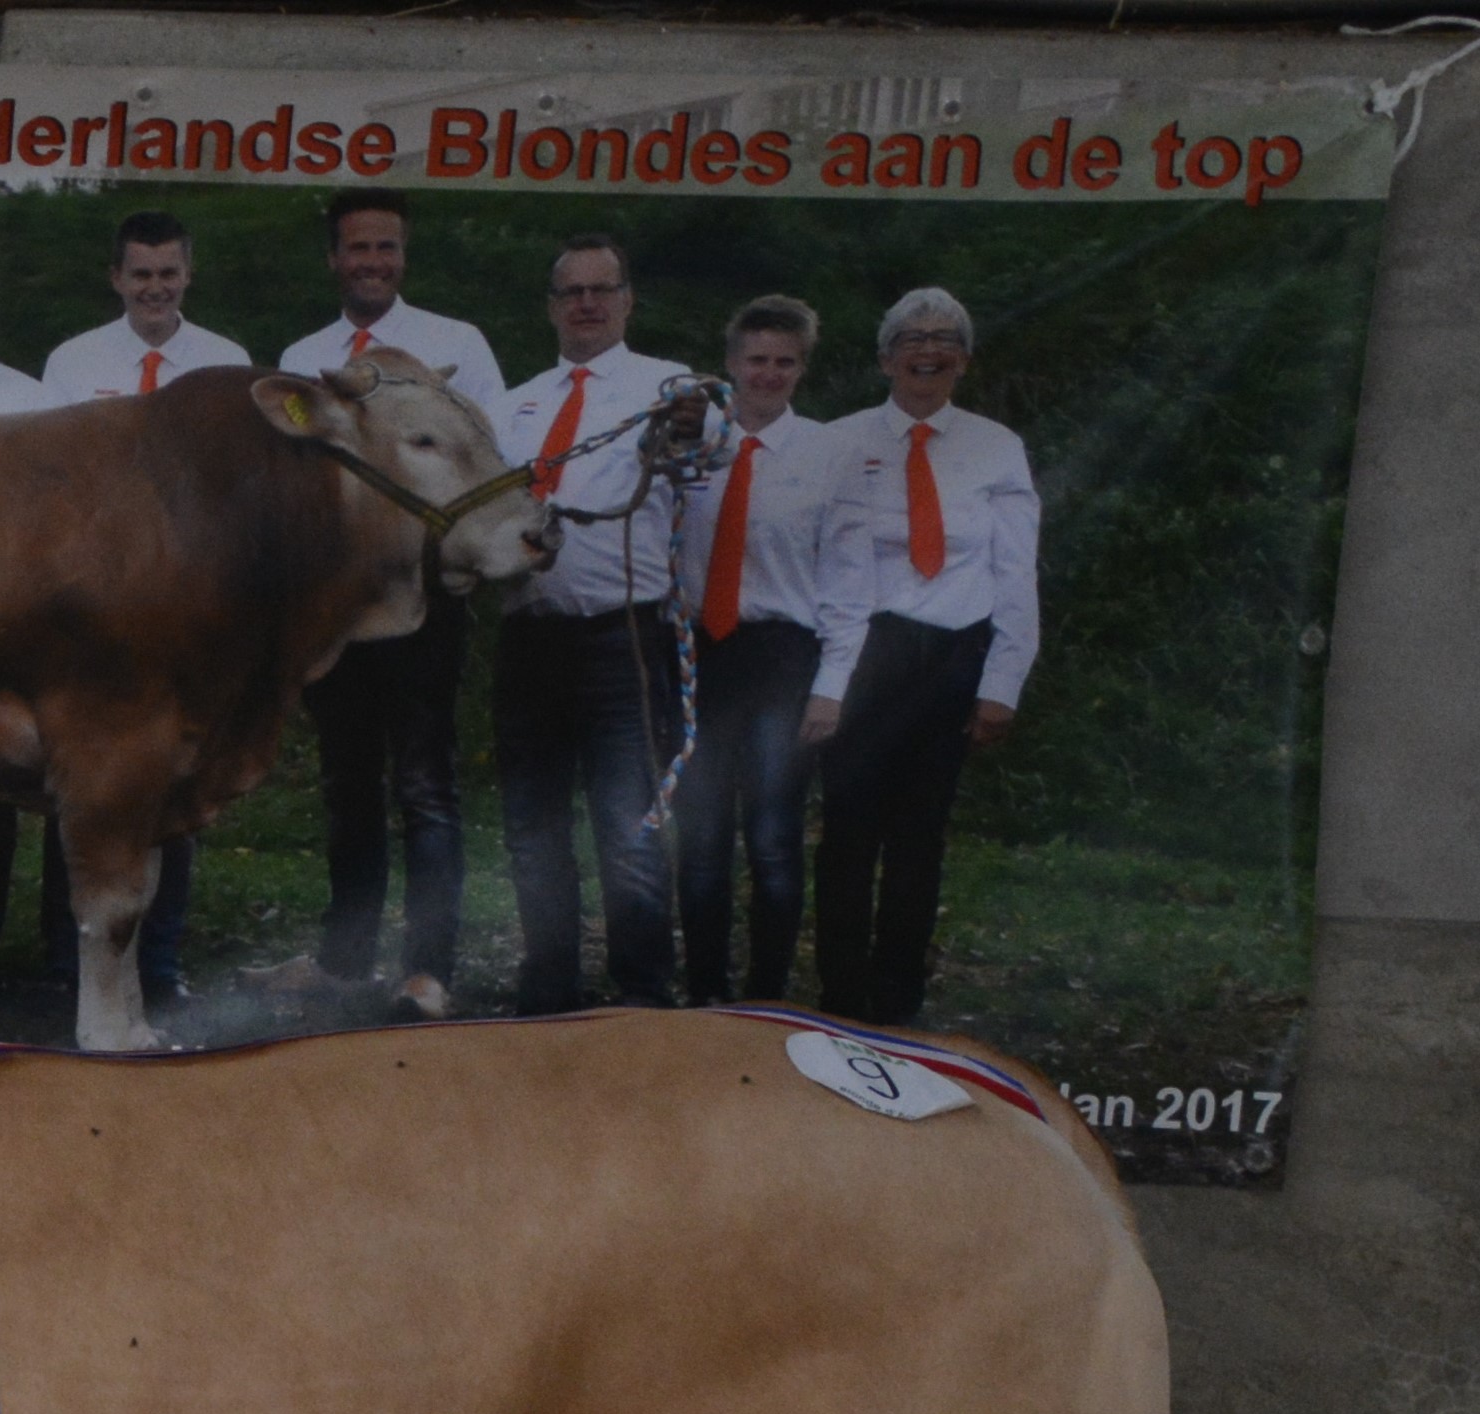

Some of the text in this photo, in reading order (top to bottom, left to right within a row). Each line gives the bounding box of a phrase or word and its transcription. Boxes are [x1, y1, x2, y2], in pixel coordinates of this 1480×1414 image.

[425, 106, 793, 188] Blondes
[819, 129, 982, 189] aan
[1012, 116, 1122, 192] de
[1150, 120, 1304, 207] top
[1151, 1086, 1283, 1134] 2017
